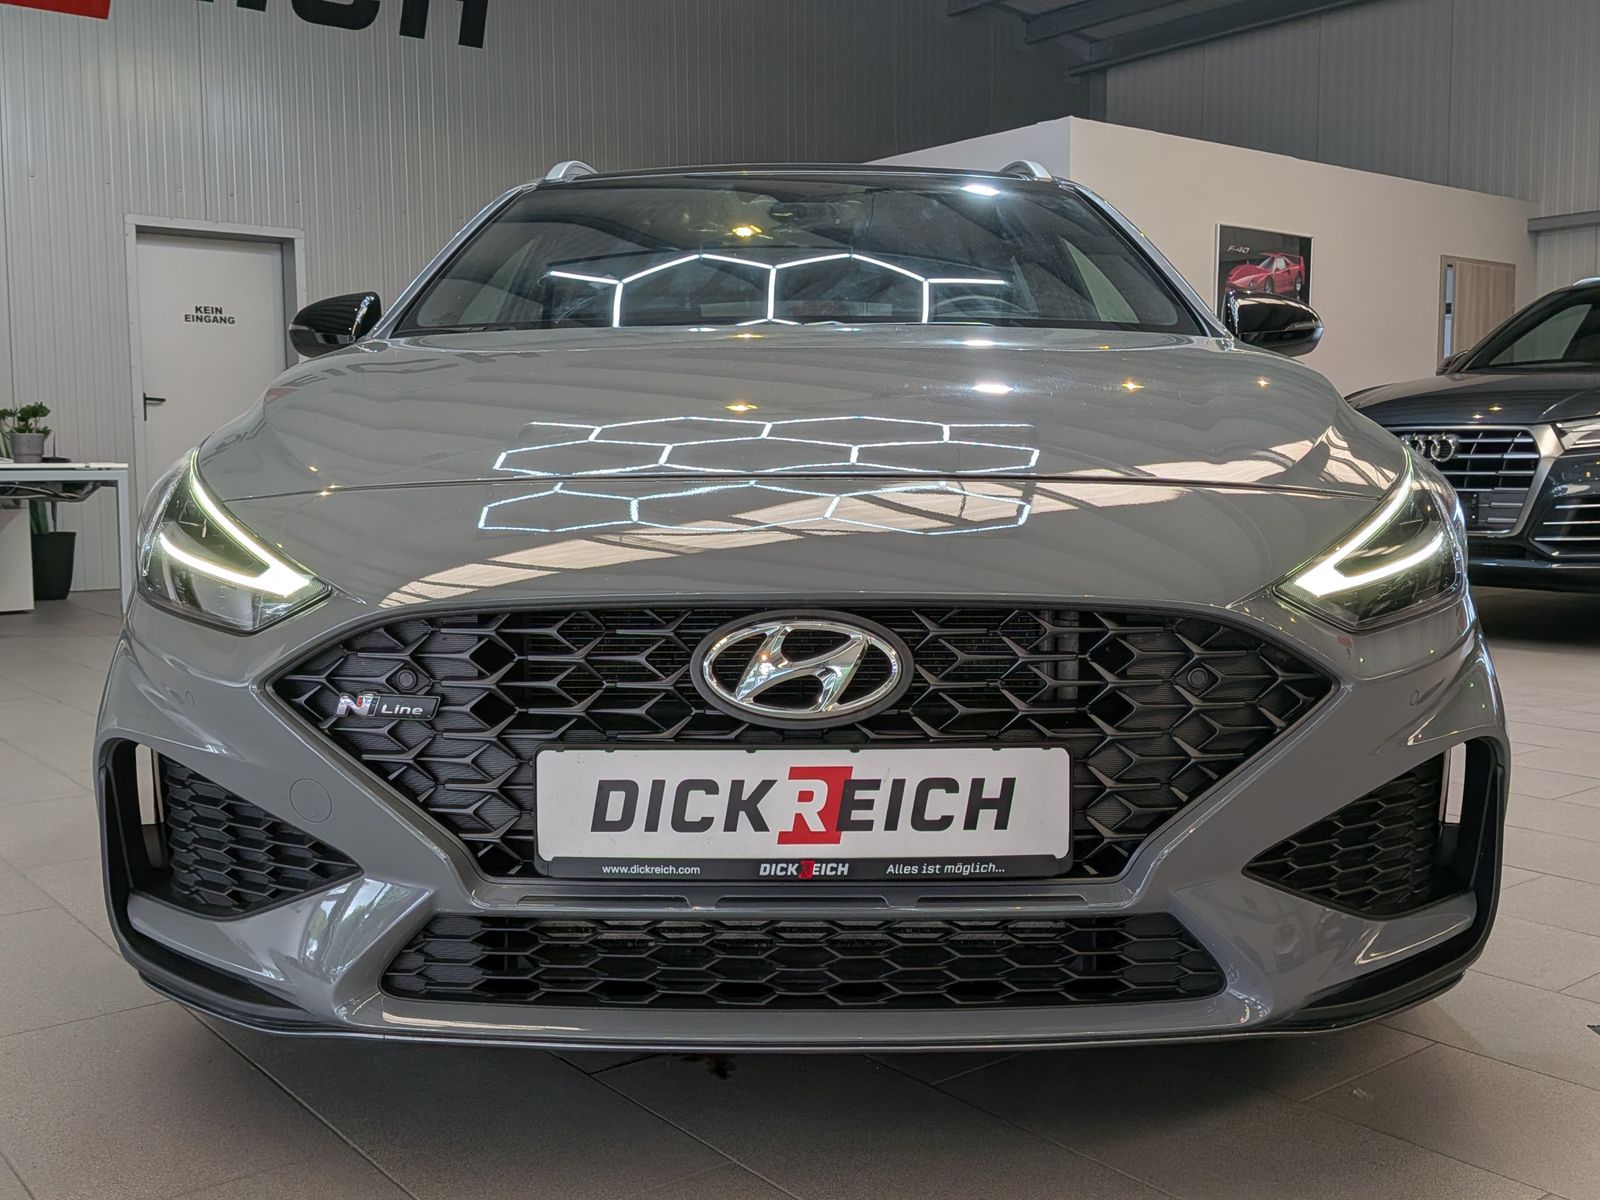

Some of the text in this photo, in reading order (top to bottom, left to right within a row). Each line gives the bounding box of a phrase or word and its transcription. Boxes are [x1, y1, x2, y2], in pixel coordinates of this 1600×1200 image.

[195, 305, 223, 315] KEIN
[184, 314, 236, 325] EINGANG
[381, 704, 424, 715] Line
[590, 775, 1017, 835] DICKREICH
[601, 864, 701, 875] www.dickreich.com
[886, 862, 1005, 876] Alles ist möglich...
